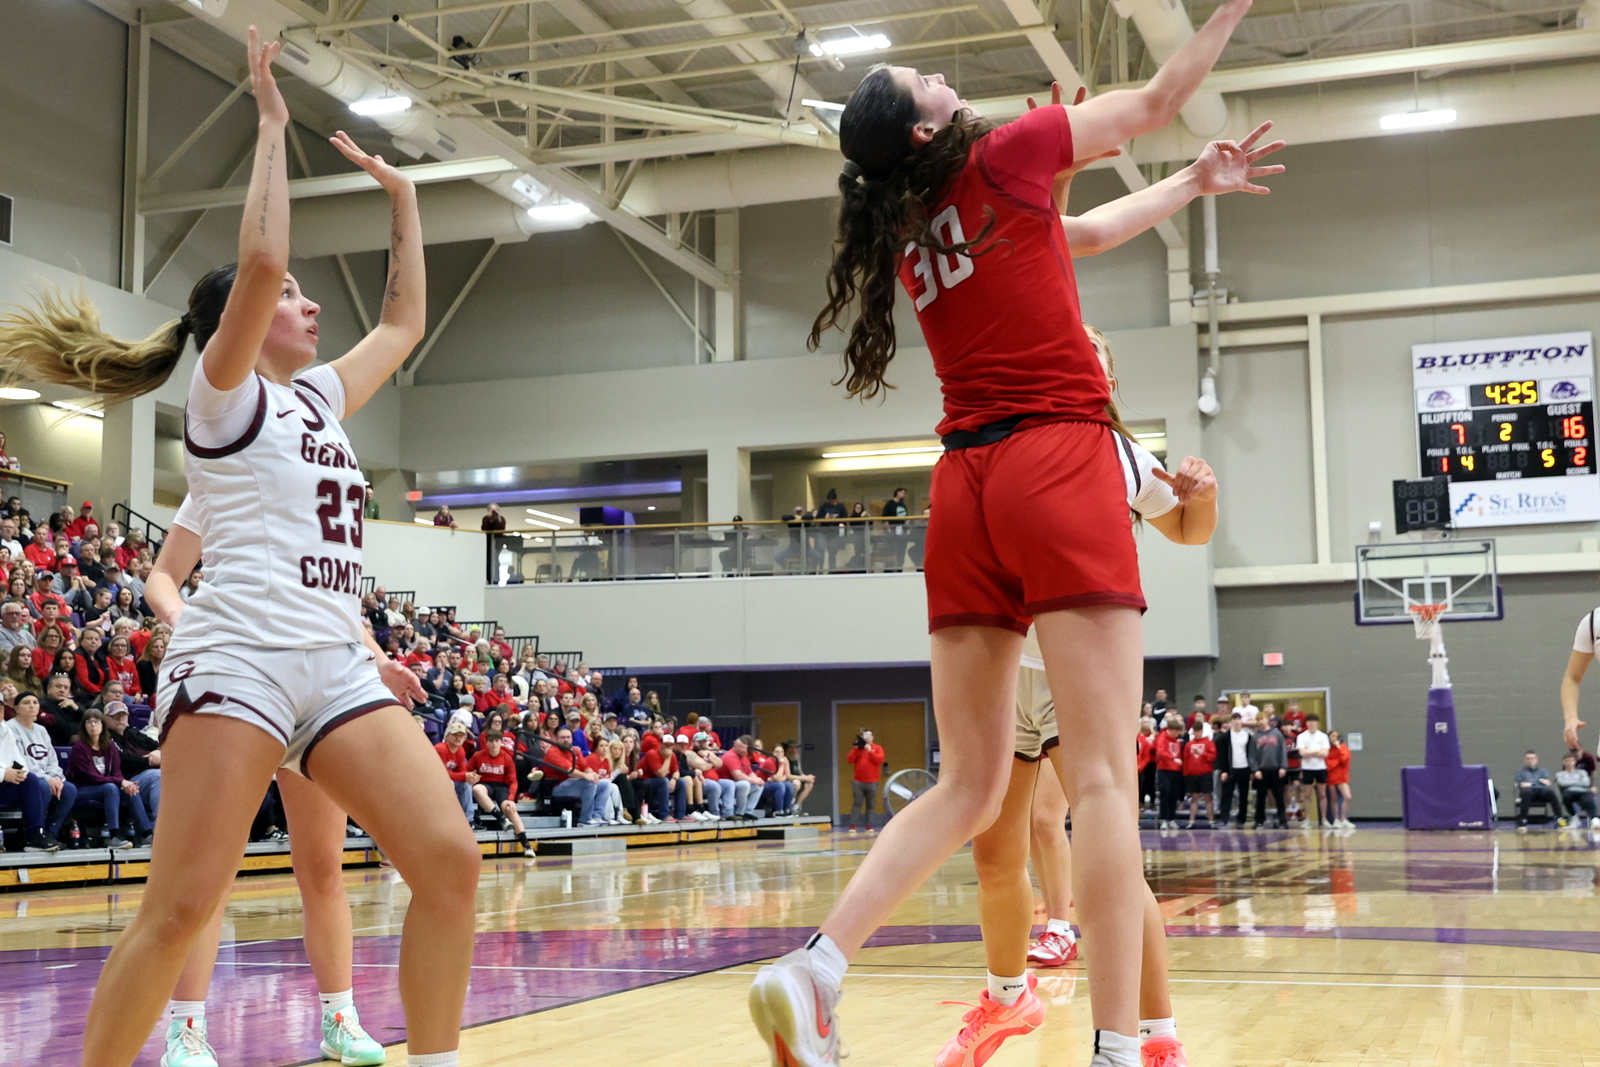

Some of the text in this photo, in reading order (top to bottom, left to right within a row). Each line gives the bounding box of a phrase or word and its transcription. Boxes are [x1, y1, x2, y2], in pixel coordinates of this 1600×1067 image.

[904, 204, 975, 313] 30
[1416, 344, 1588, 370] BLUFFTON
[1485, 380, 1538, 405] 4:25
[1421, 410, 1473, 425] BLUFFTON
[1491, 413, 1518, 422] PERIOD
[1547, 403, 1583, 417] GUEST
[1450, 423, 1465, 445] 7
[1499, 422, 1513, 442] 2
[1562, 415, 1586, 439] 16
[1426, 448, 1450, 457] FOULS
[1564, 439, 1589, 449] FOULS
[1460, 455, 1474, 471] 4
[1541, 448, 1555, 468] 5
[1573, 447, 1587, 466] 2
[1496, 471, 1522, 480] MATCH
[315, 477, 365, 551] 23
[169, 660, 196, 683] G
